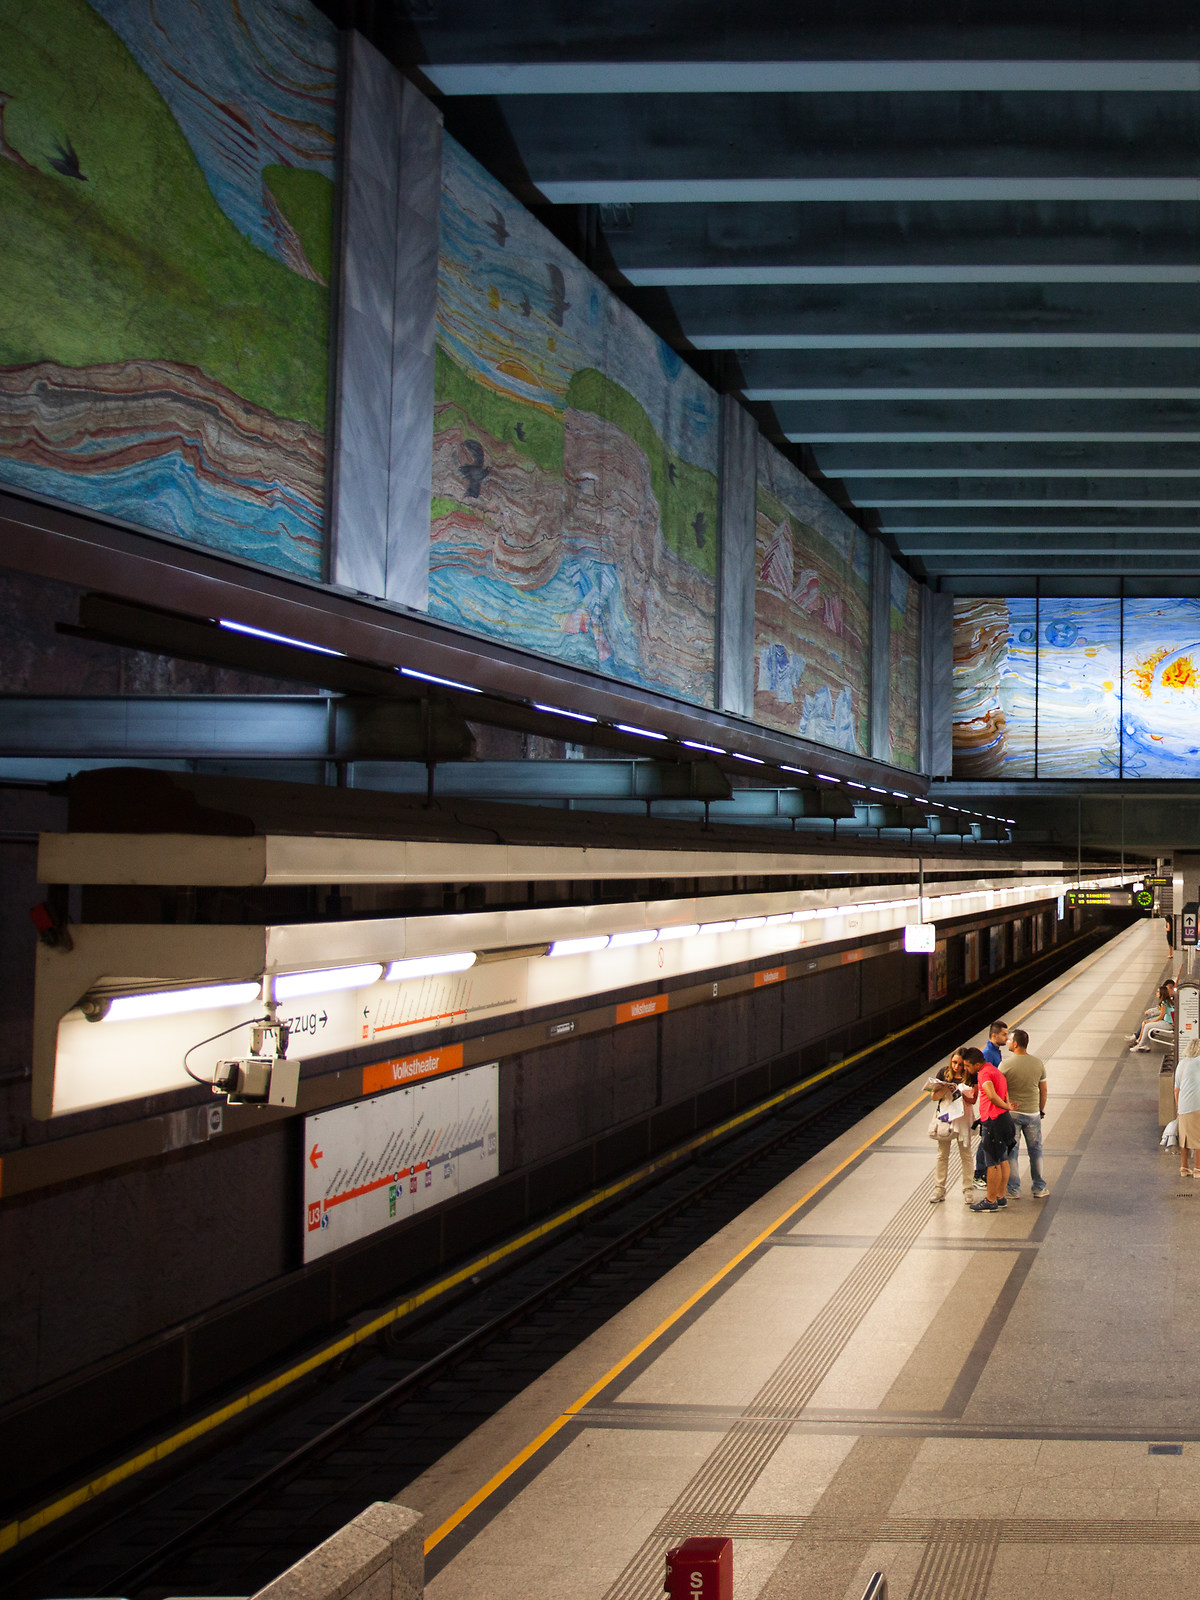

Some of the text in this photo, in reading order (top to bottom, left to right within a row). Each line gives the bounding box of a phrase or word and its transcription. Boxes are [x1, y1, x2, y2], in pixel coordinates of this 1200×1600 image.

[1185, 928, 1195, 936] U2
[392, 1055, 440, 1081] Volkstheater
[308, 1207, 320, 1225] U3
